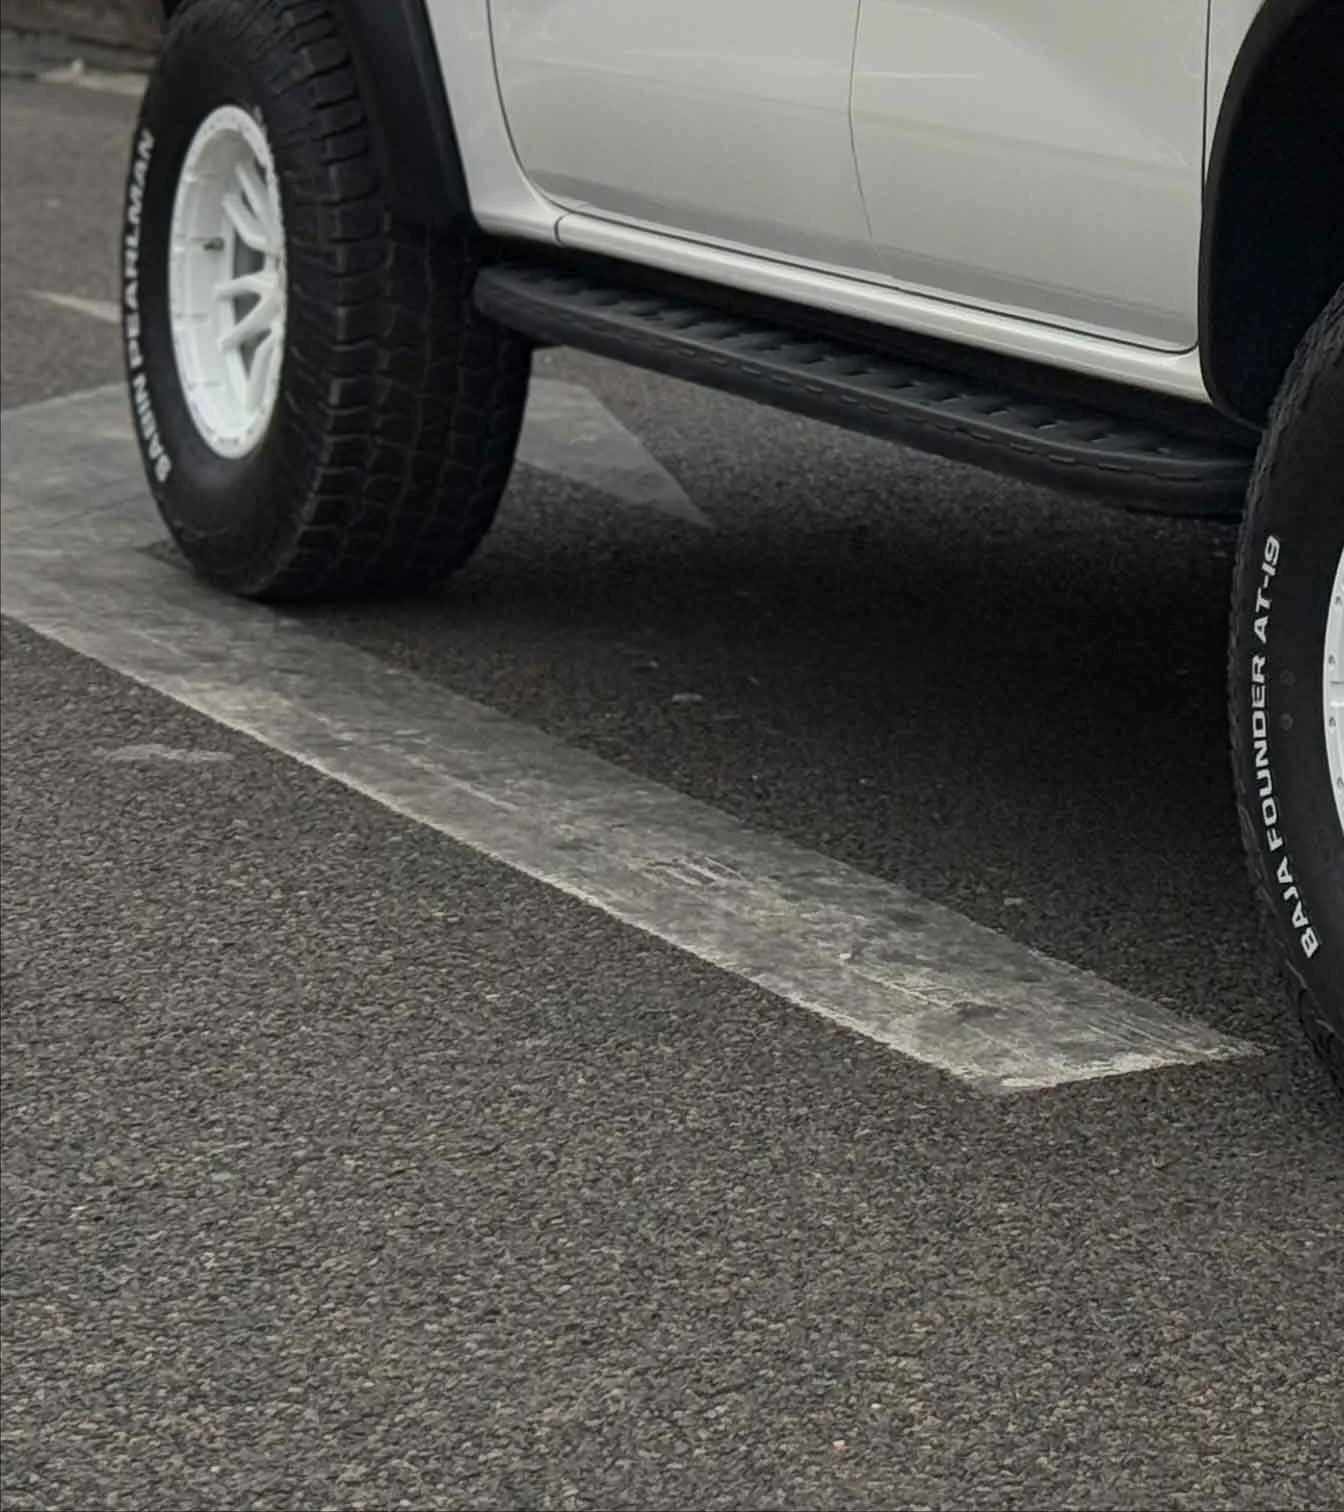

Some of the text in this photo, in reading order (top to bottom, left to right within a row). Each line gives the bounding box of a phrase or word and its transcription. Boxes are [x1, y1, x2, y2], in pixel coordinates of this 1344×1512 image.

[1251, 534, 1320, 959] BAJA FOUNDER AT-19
